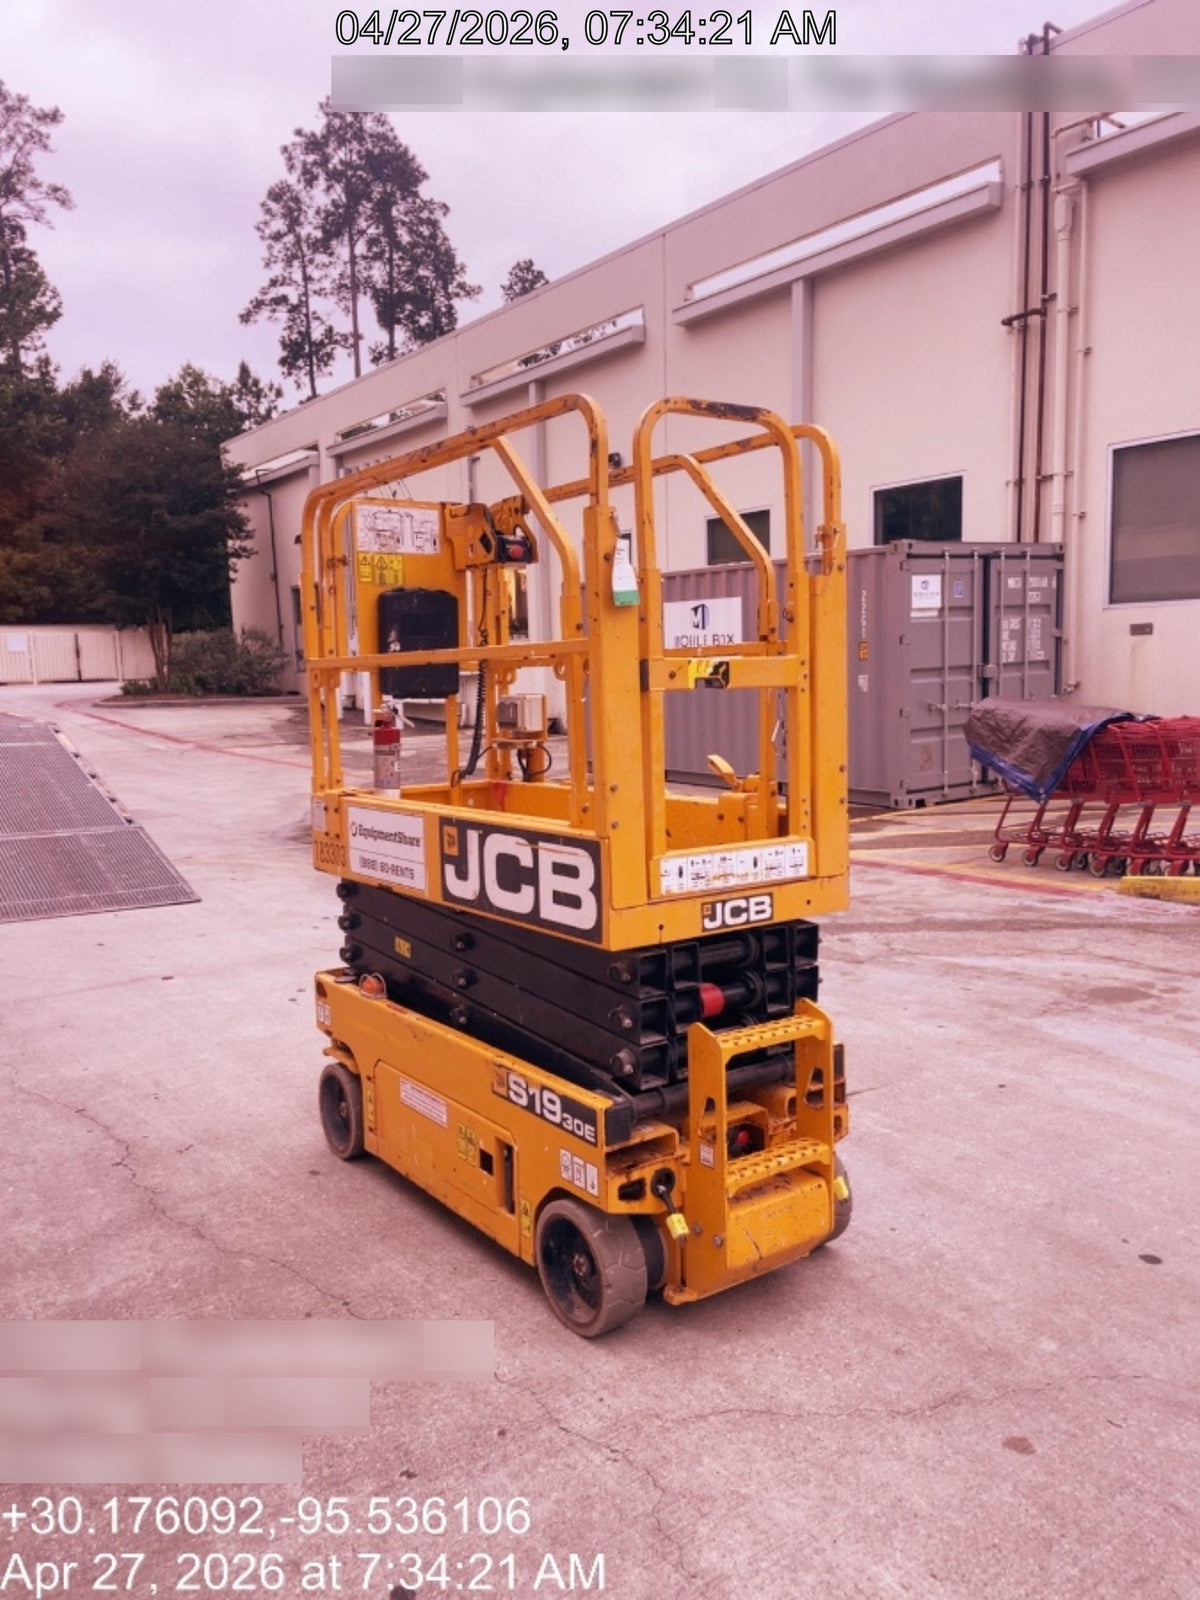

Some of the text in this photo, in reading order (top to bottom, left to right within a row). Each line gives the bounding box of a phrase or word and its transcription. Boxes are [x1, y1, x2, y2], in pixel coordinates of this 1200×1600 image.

[358, 823, 421, 848] EquipmentShare
[444, 829, 598, 931] JCB
[703, 895, 773, 930] JCB
